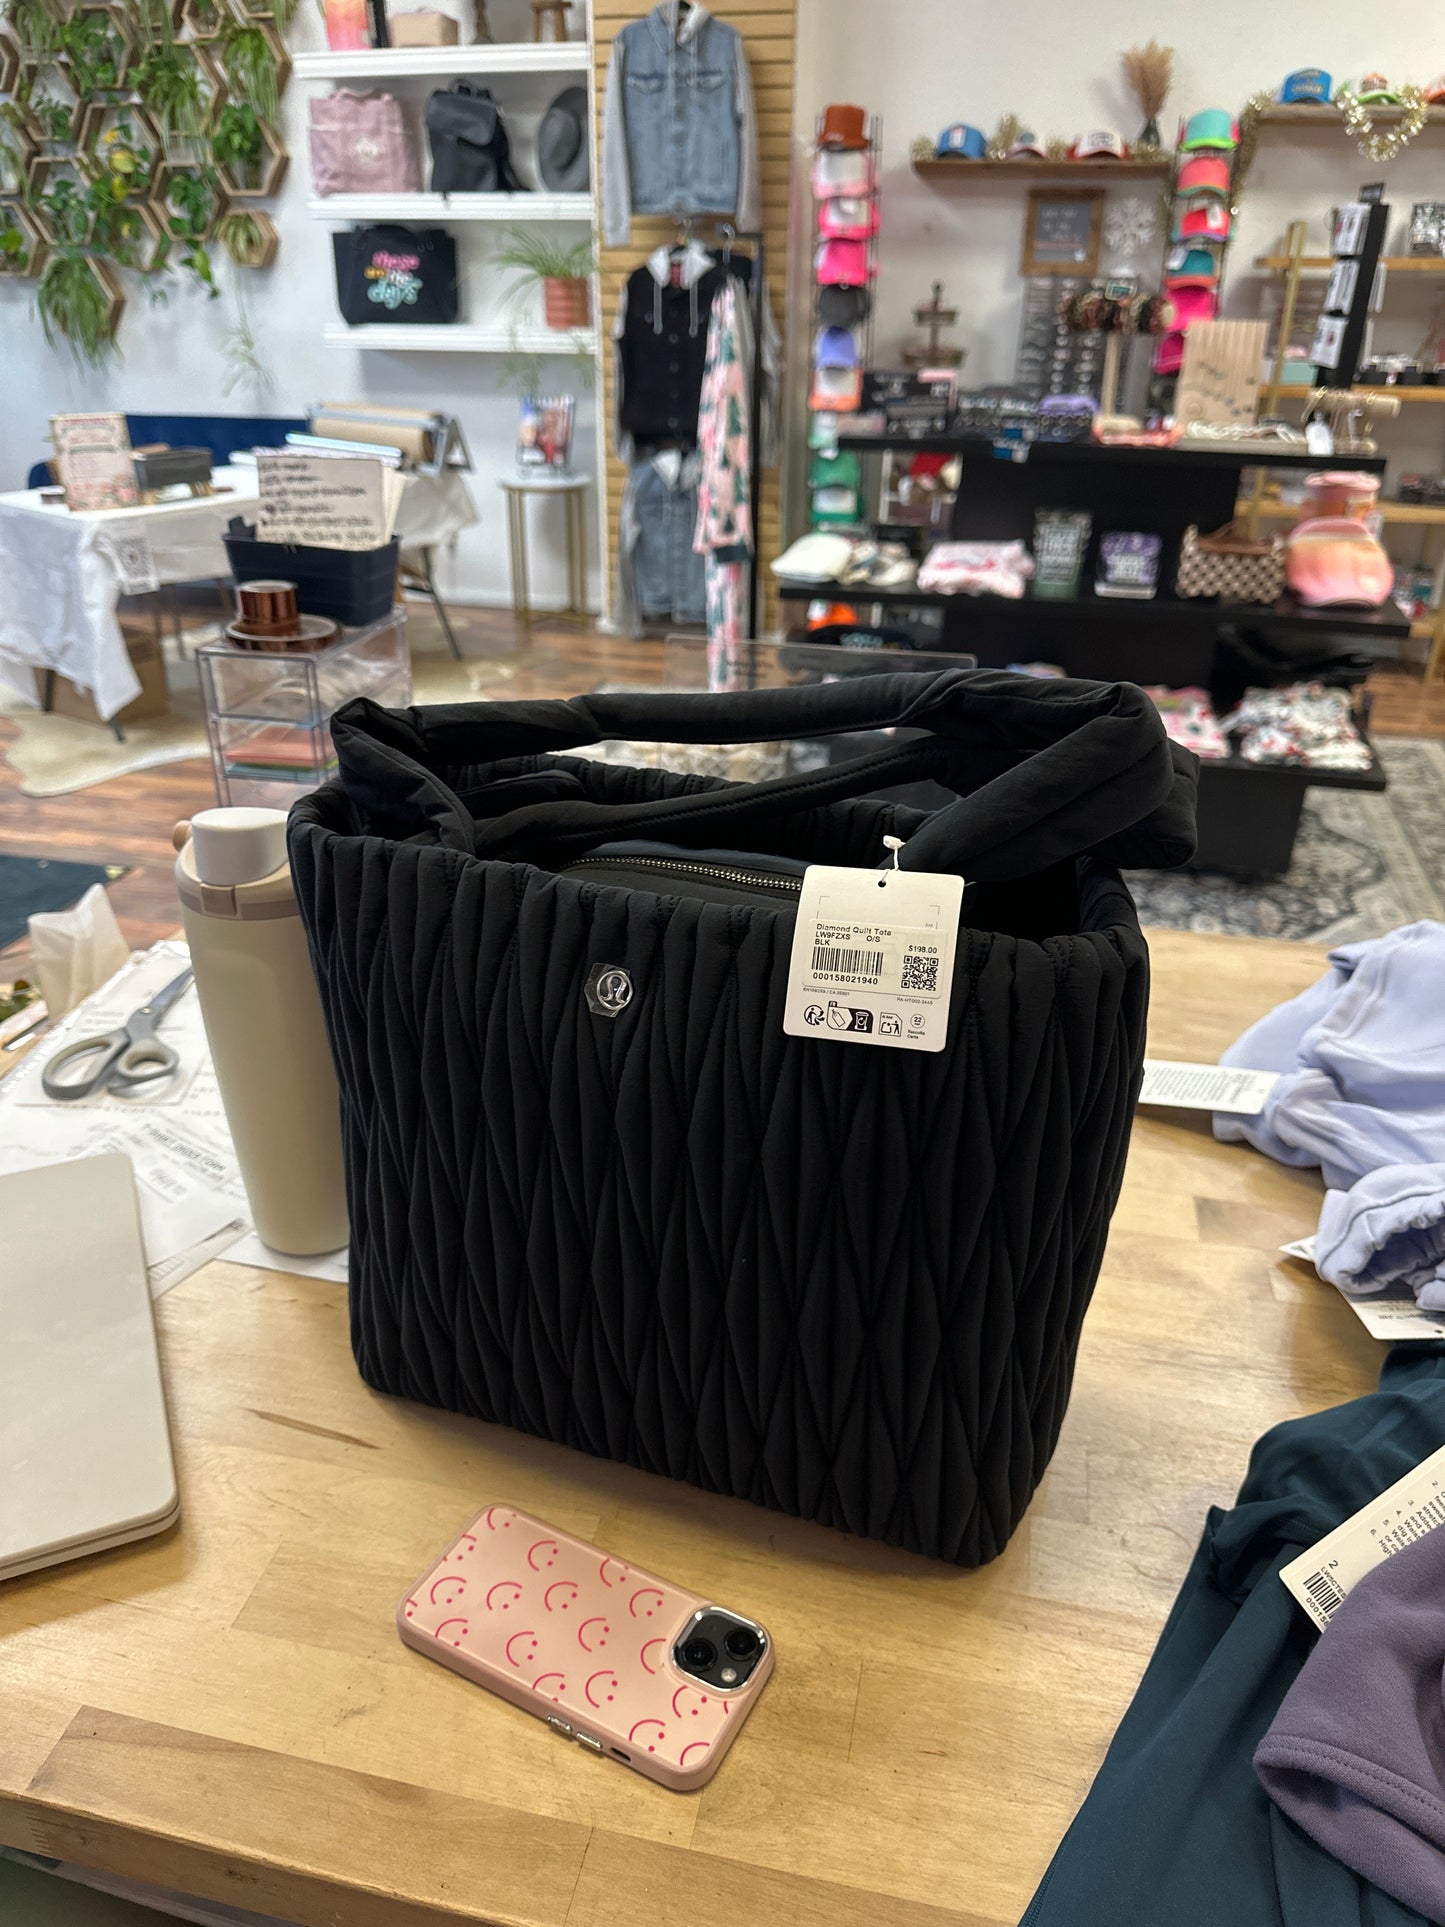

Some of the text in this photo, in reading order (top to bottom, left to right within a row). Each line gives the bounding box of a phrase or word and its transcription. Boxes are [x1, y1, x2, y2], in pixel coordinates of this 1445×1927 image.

[368, 278, 423, 309] days
[816, 923, 892, 936] Diamond Quilt Tote
[814, 938, 831, 946] BLK
[815, 931, 881, 943] LW9FZXS O/S
[908, 945, 937, 954] $198.00
[812, 972, 878, 985] 000158021940
[1410, 1515, 1423, 1529] and
[1328, 1559, 1339, 1570] 2
